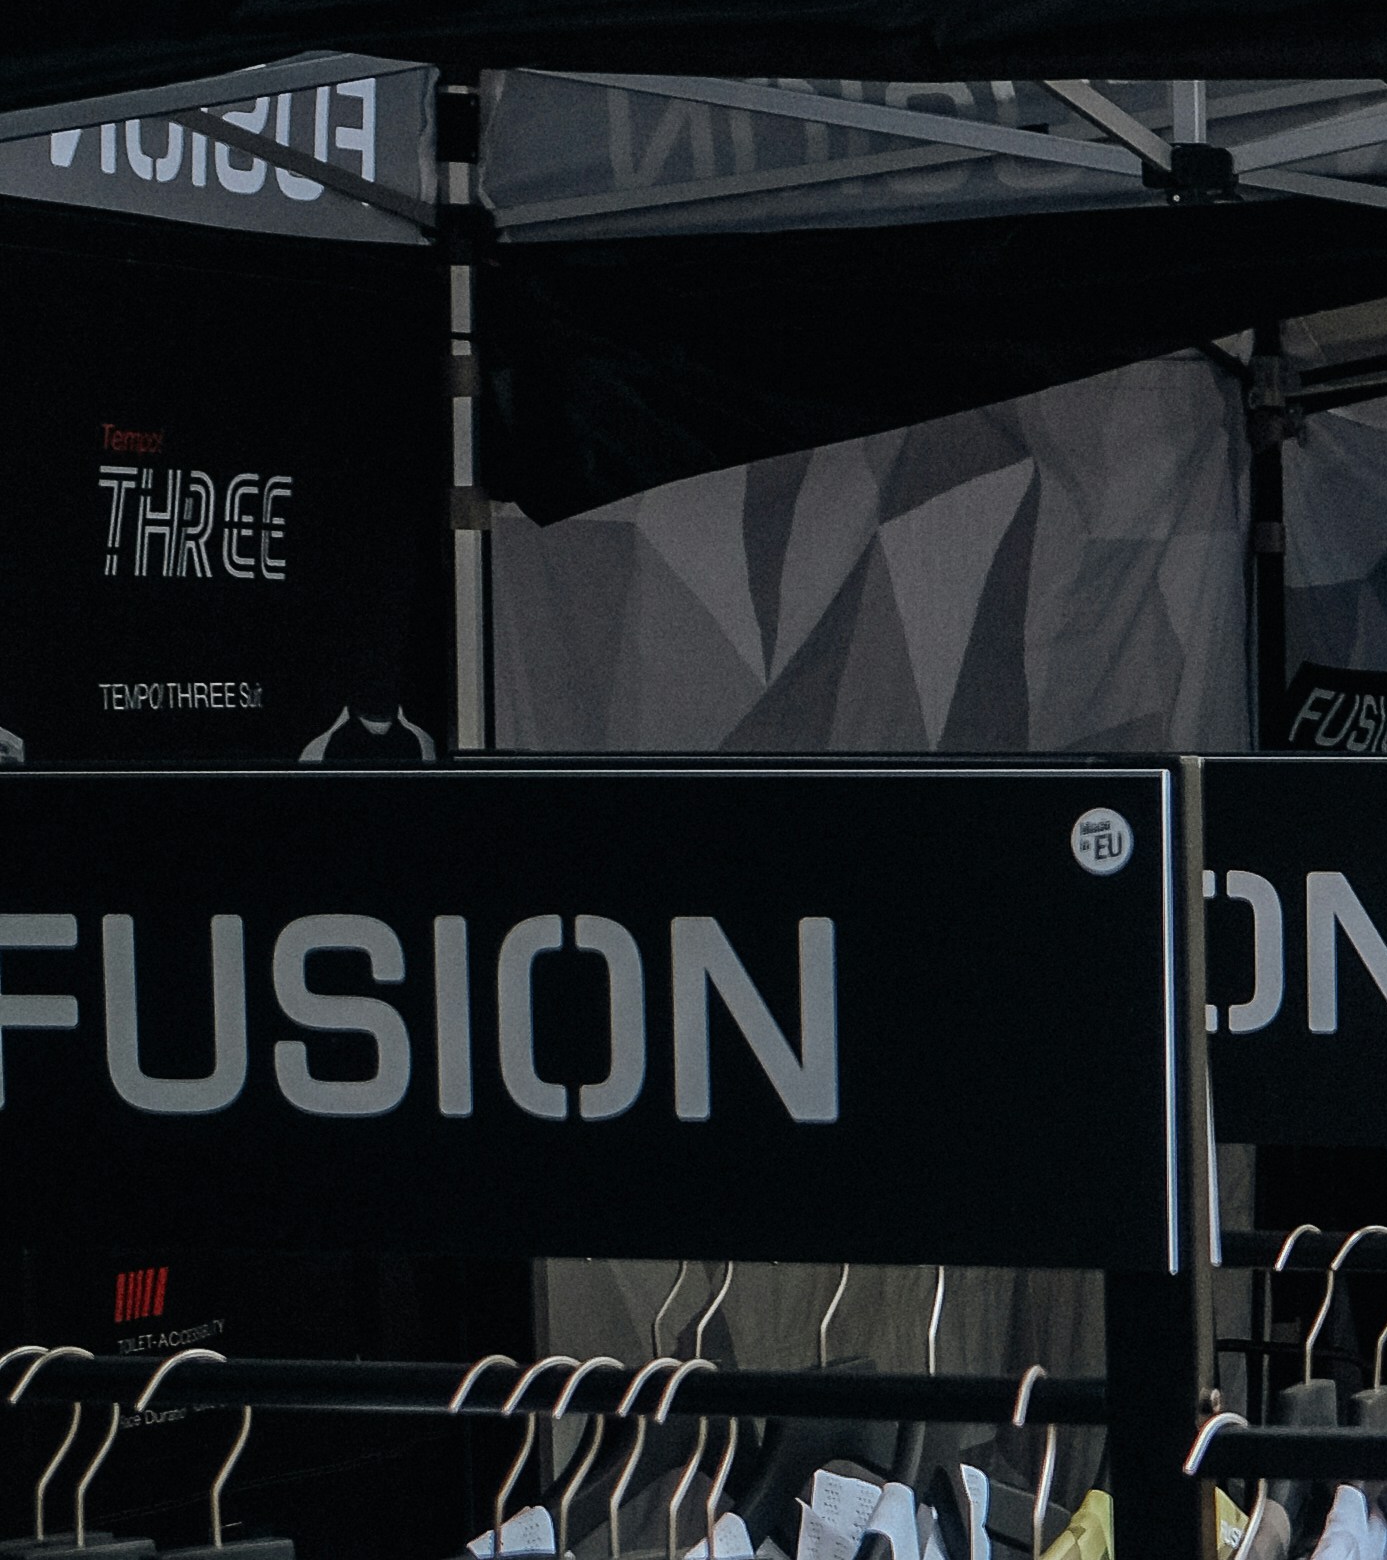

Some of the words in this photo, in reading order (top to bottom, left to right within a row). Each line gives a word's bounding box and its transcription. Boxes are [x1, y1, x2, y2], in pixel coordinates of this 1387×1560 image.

[98, 465, 293, 580] THREE
[166, 682, 236, 709] THREE
[1094, 831, 1123, 860] EU
